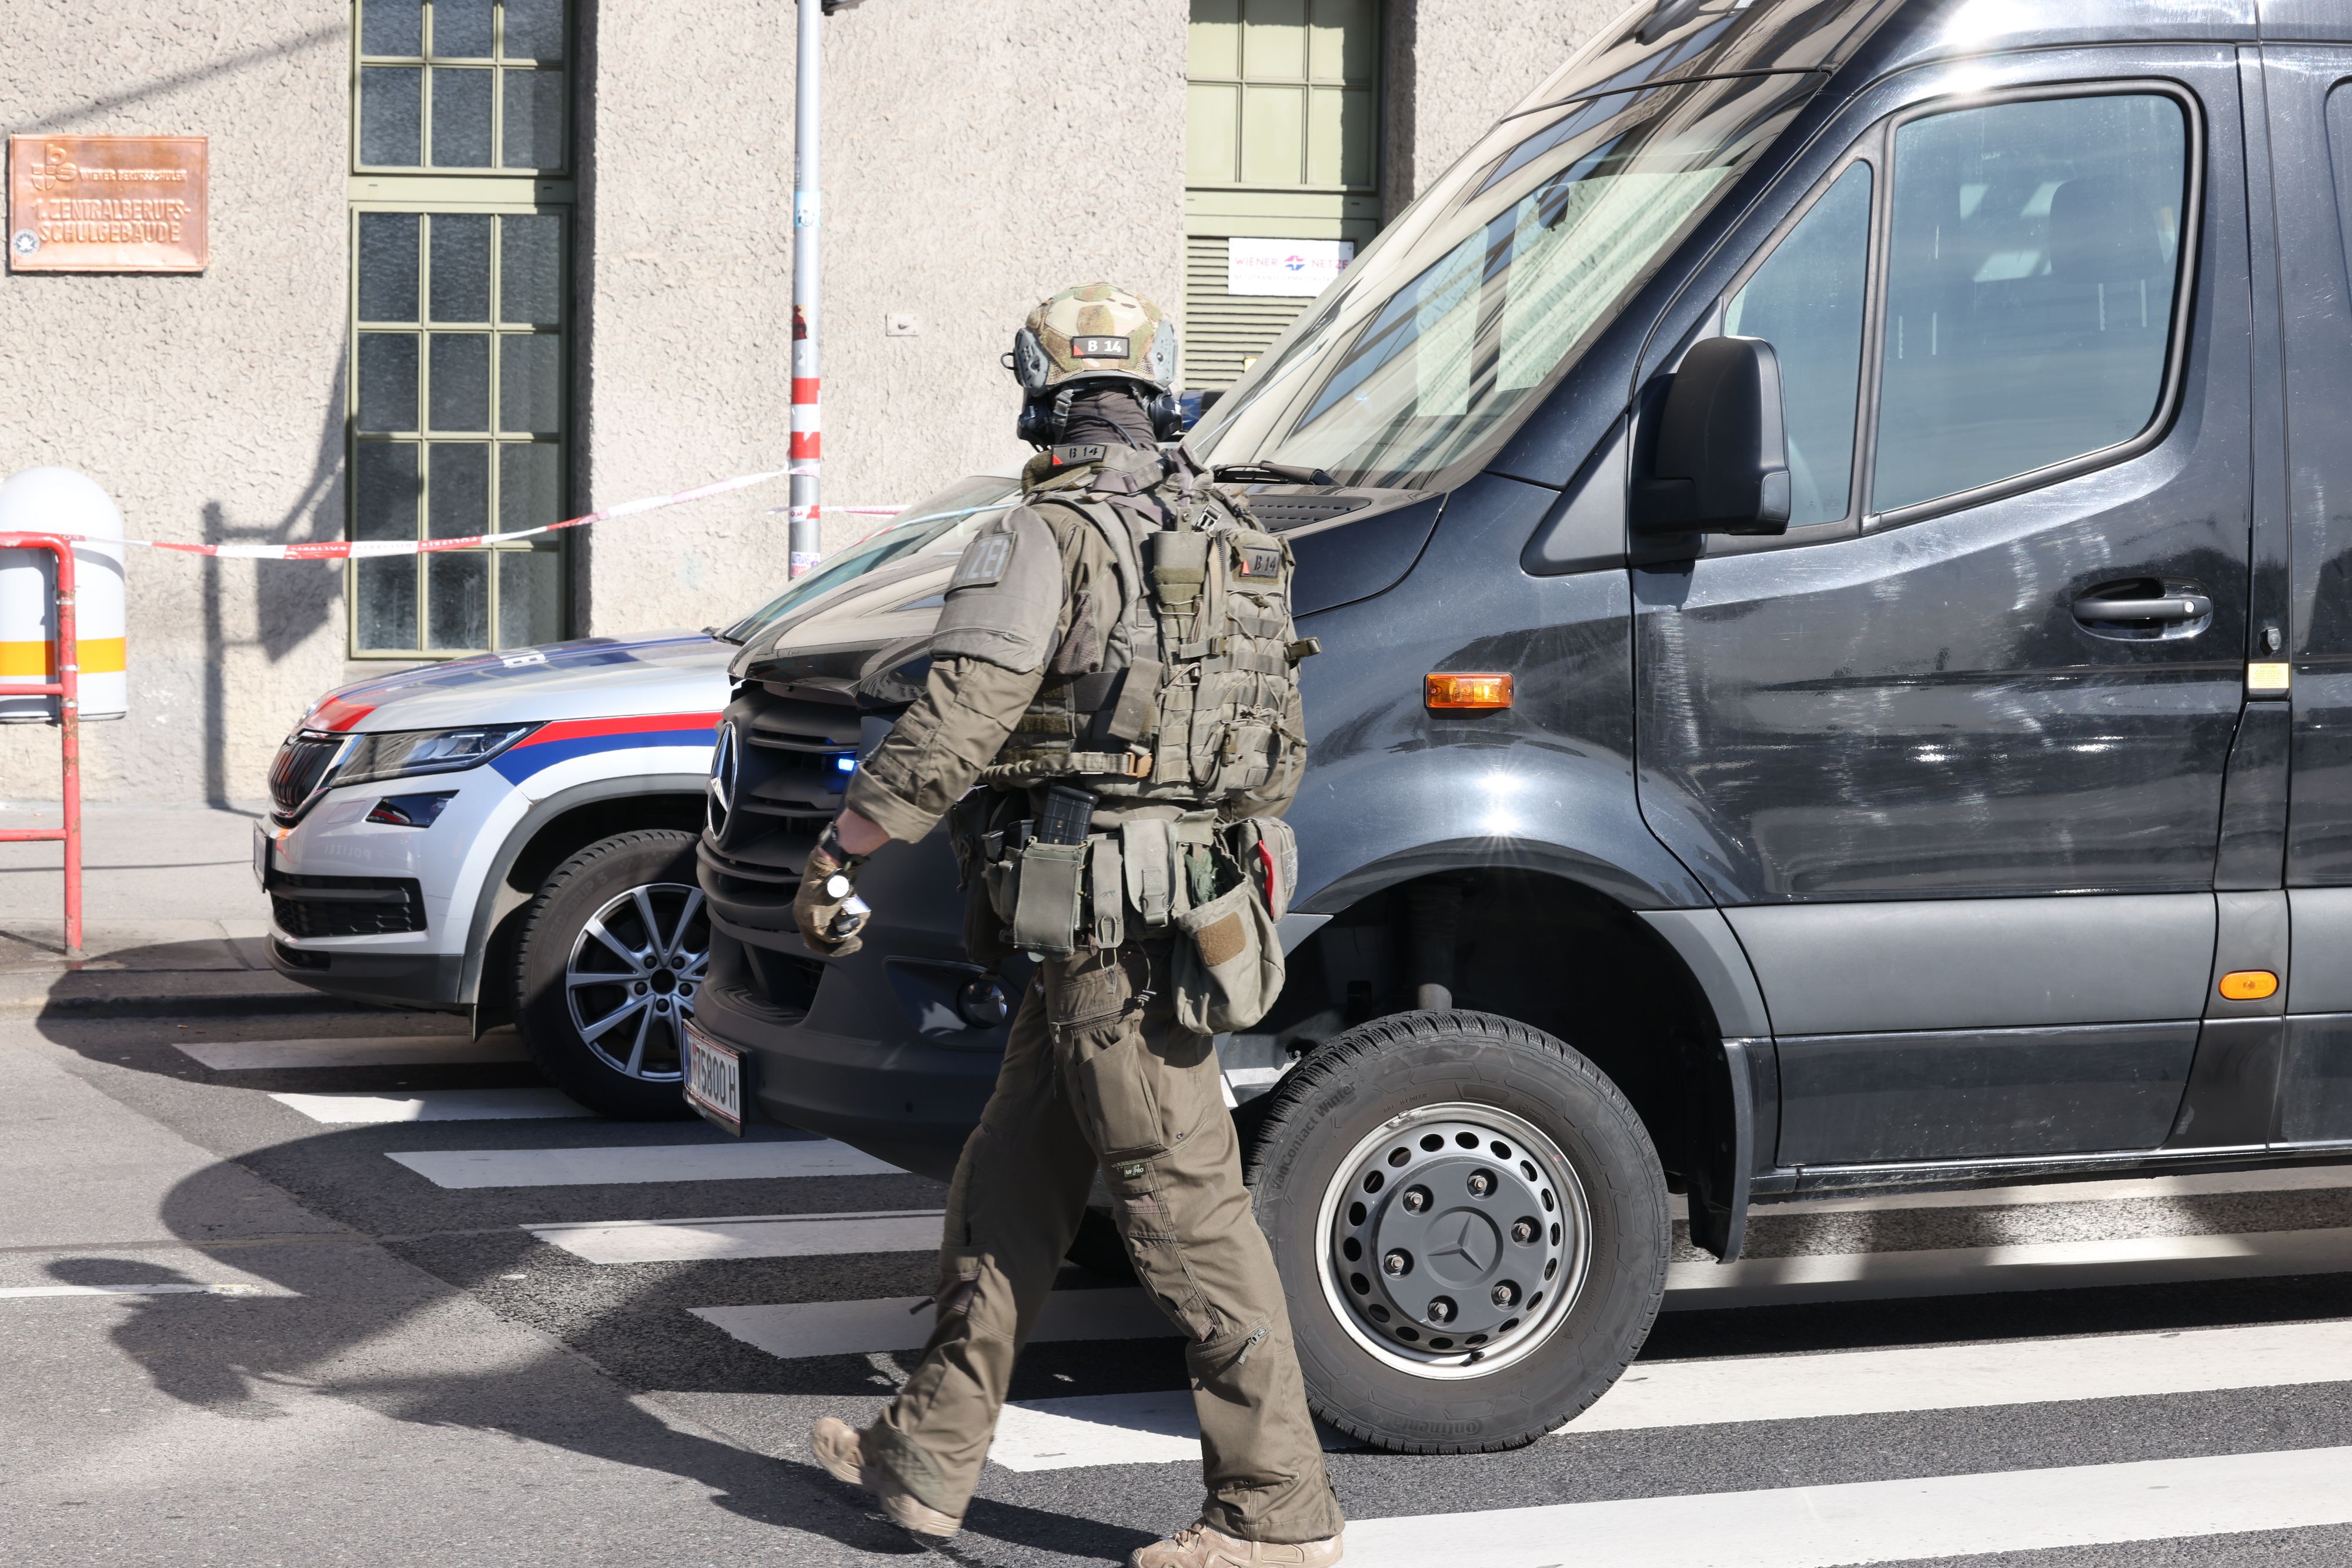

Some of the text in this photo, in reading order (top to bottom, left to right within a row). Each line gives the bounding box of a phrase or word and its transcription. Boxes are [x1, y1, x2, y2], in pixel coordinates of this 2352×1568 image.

[50, 198, 191, 220] ZENTRALBERUFS-
[1235, 257, 1349, 269] WIENER NETZE
[1088, 340, 1122, 353] B 14
[1069, 447, 1098, 459] B 14
[1254, 555, 1277, 572] B 14
[729, 1064, 737, 1111] H
[1271, 1081, 1356, 1189] VanContact Winter
